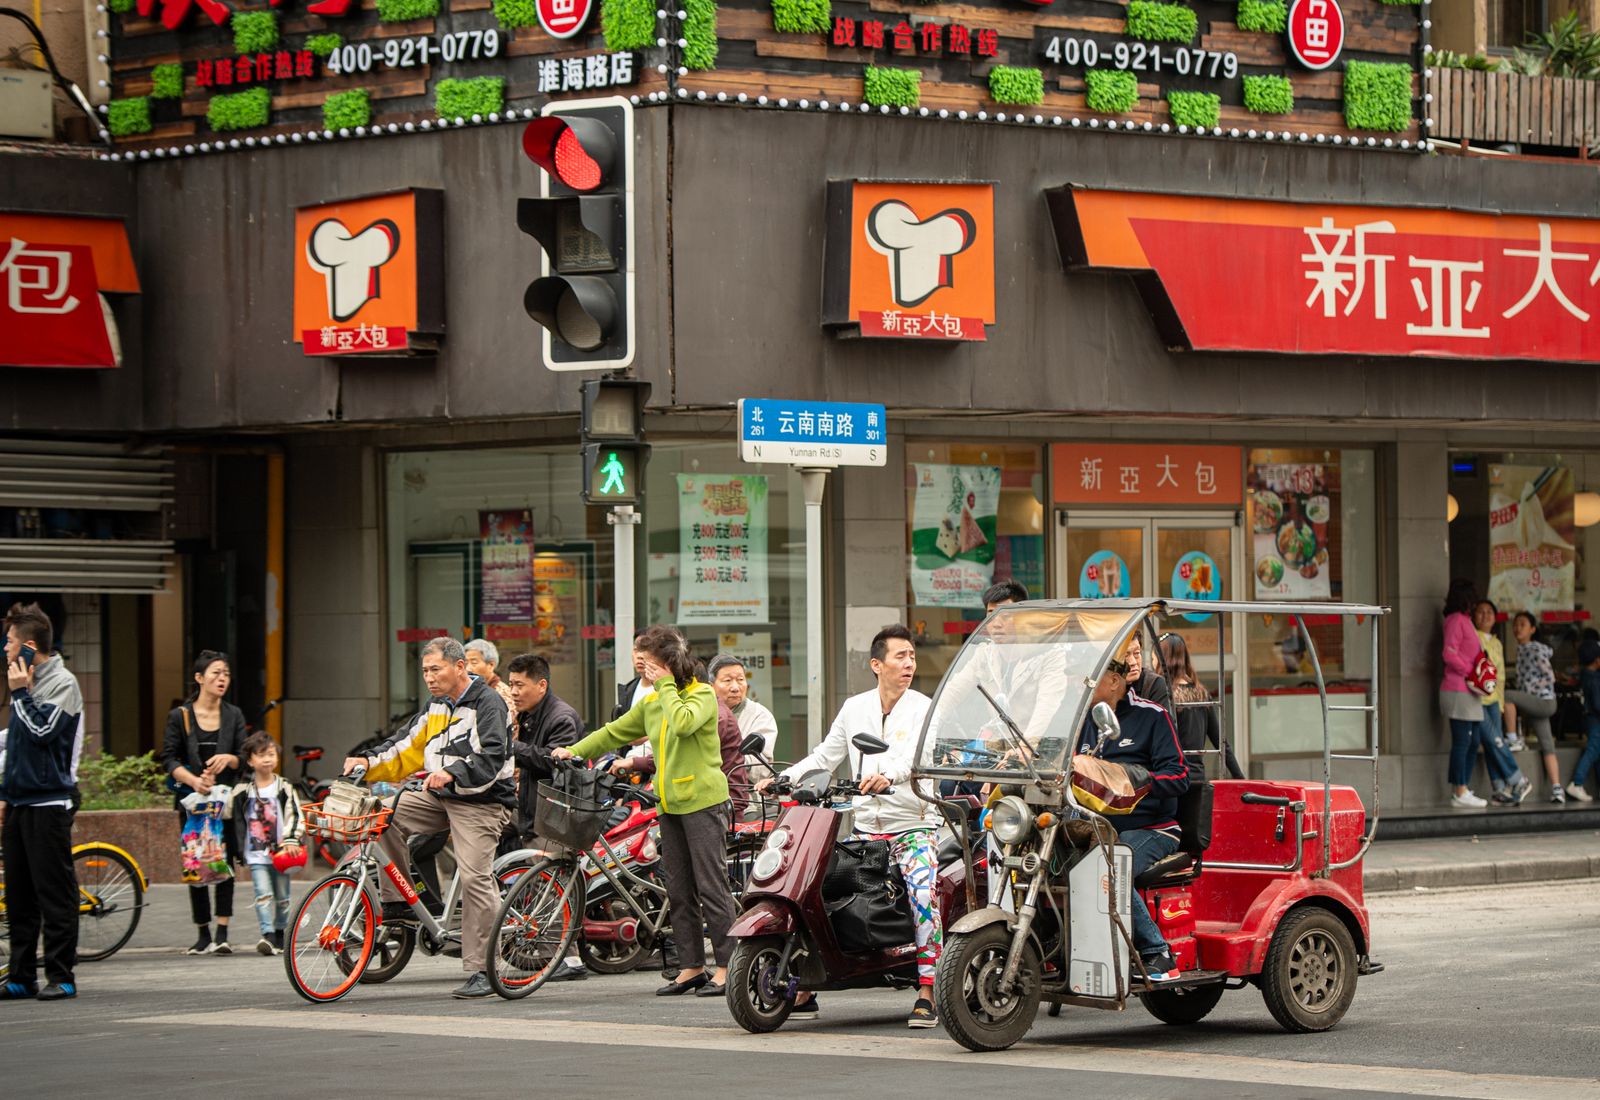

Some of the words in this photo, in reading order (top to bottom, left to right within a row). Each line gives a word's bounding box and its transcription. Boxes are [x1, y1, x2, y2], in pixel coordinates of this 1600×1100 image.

[195, 50, 314, 87] 战略合作热线
[327, 28, 499, 75] 400-921-0779
[833, 17, 999, 57] 战略合作热线
[1046, 36, 1238, 79] 400-921-0779
[538, 51, 633, 93] 淮海路店
[0, 237, 80, 314] 包
[1301, 217, 1600, 338] 新亚大
[320, 323, 389, 350] 新亞大包
[882, 310, 963, 338] 新亞大包
[752, 407, 763, 422] 北
[778, 410, 854, 437] 云南南路
[867, 412, 878, 427] 南
[751, 425, 765, 436] 261
[866, 430, 880, 440] 301
[754, 445, 762, 457] N
[789, 447, 817, 457] Yunnan
[869, 449, 877, 461] S
[1080, 454, 1217, 495] 新亞大包
[1292, 468, 1314, 493] 13
[390, 866, 415, 898] mobike
